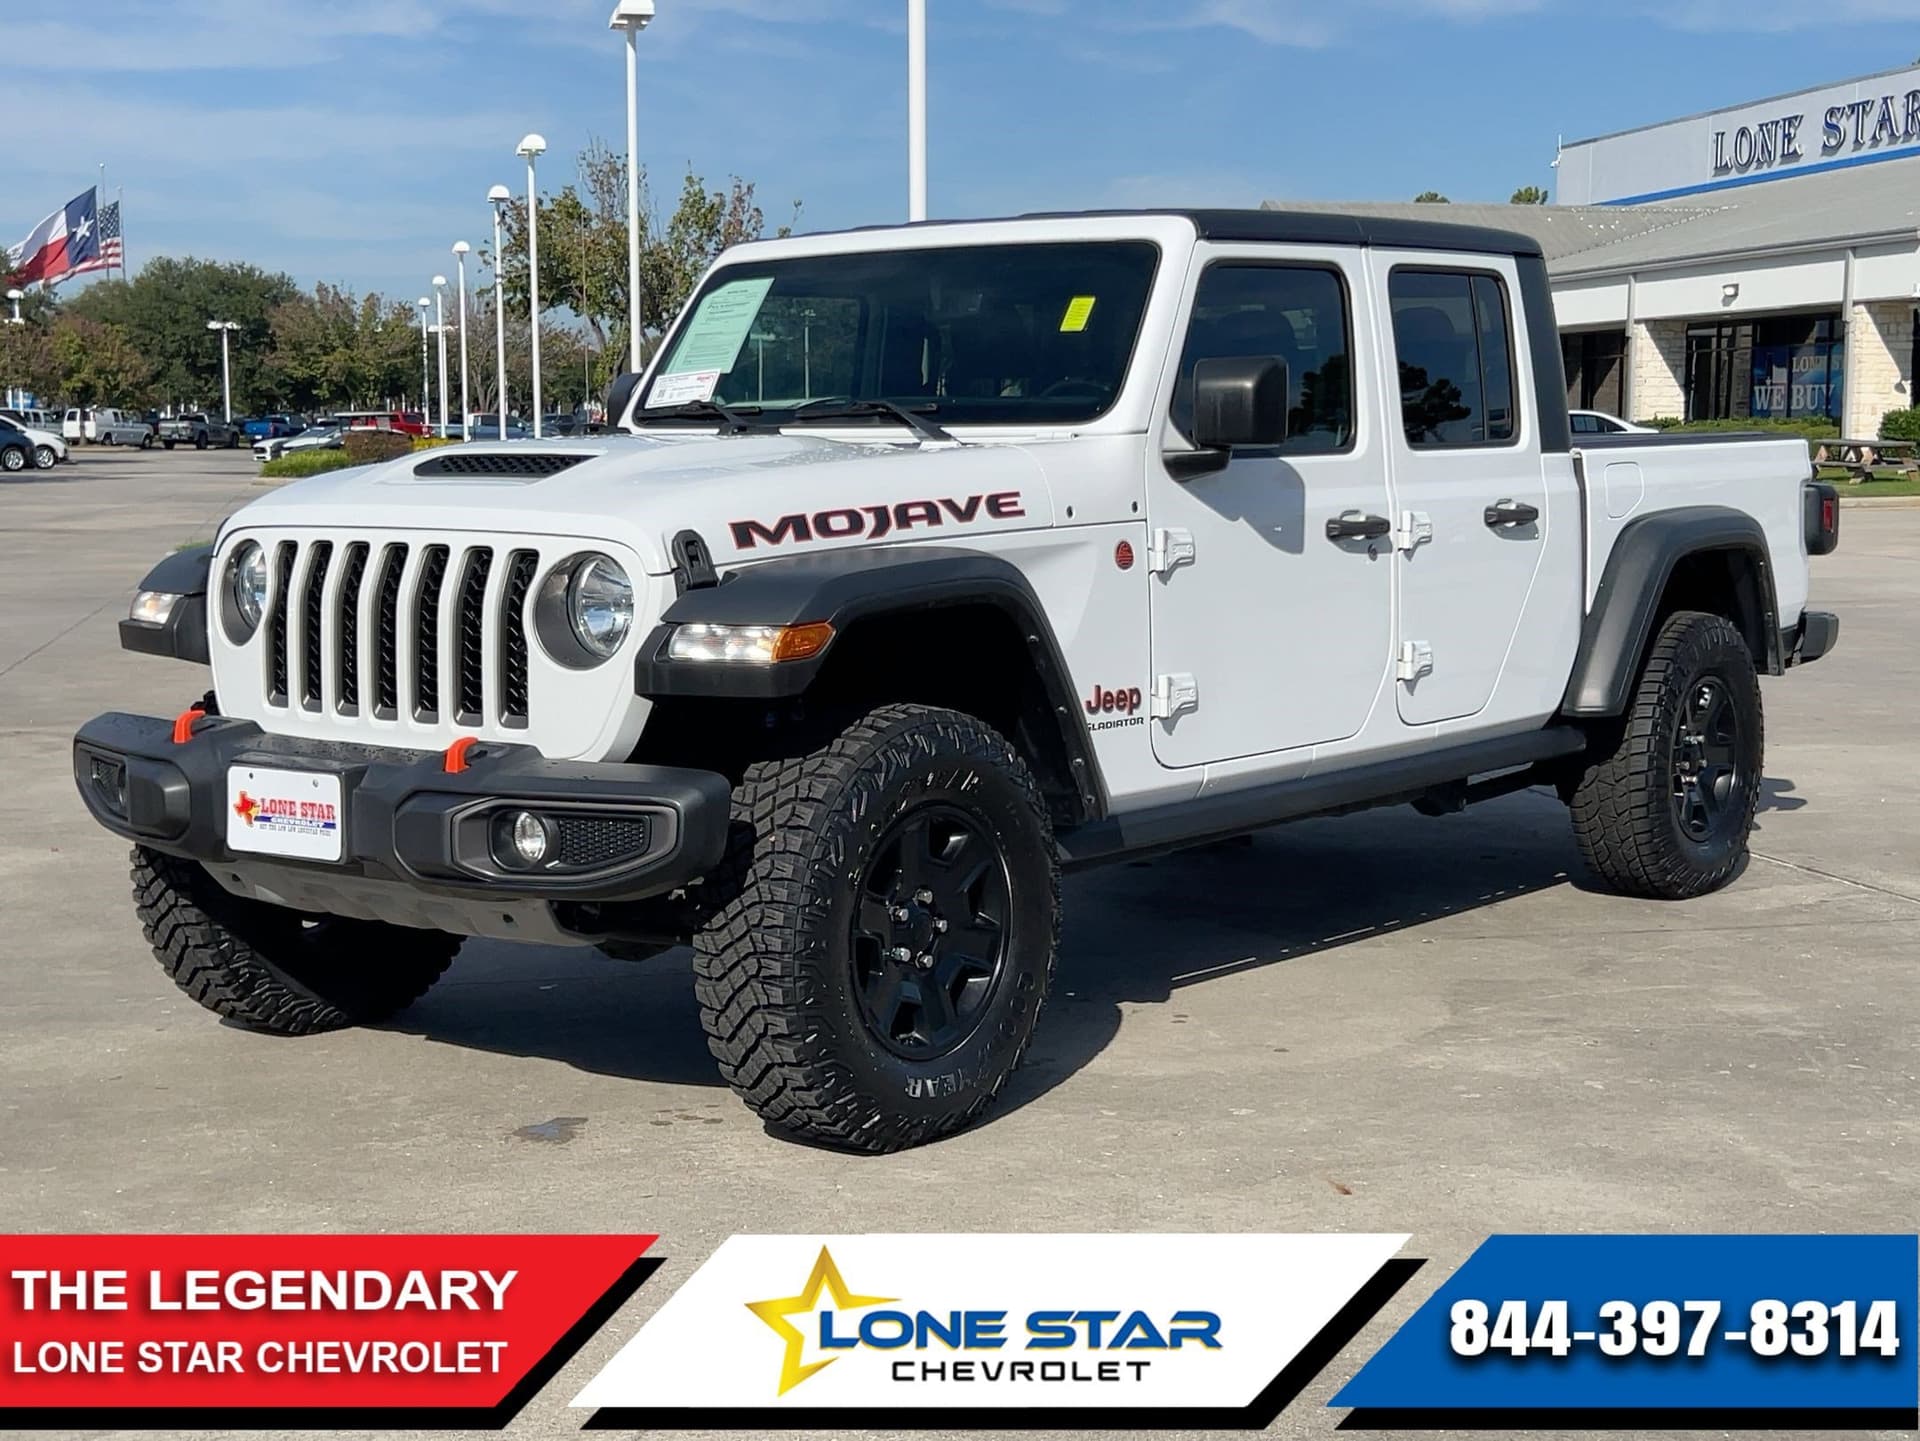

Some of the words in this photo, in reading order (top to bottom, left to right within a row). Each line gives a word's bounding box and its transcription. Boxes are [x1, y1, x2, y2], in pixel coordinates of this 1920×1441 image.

[1714, 114, 1804, 171] LONE
[1822, 90, 1920, 152] STAR
[1754, 385, 1785, 410] WE
[1790, 384, 1835, 410] BUY
[728, 491, 1026, 550] MOJAVE
[1085, 684, 1142, 716] Jeep
[260, 798, 296, 815] LONE
[301, 802, 336, 819] STAR
